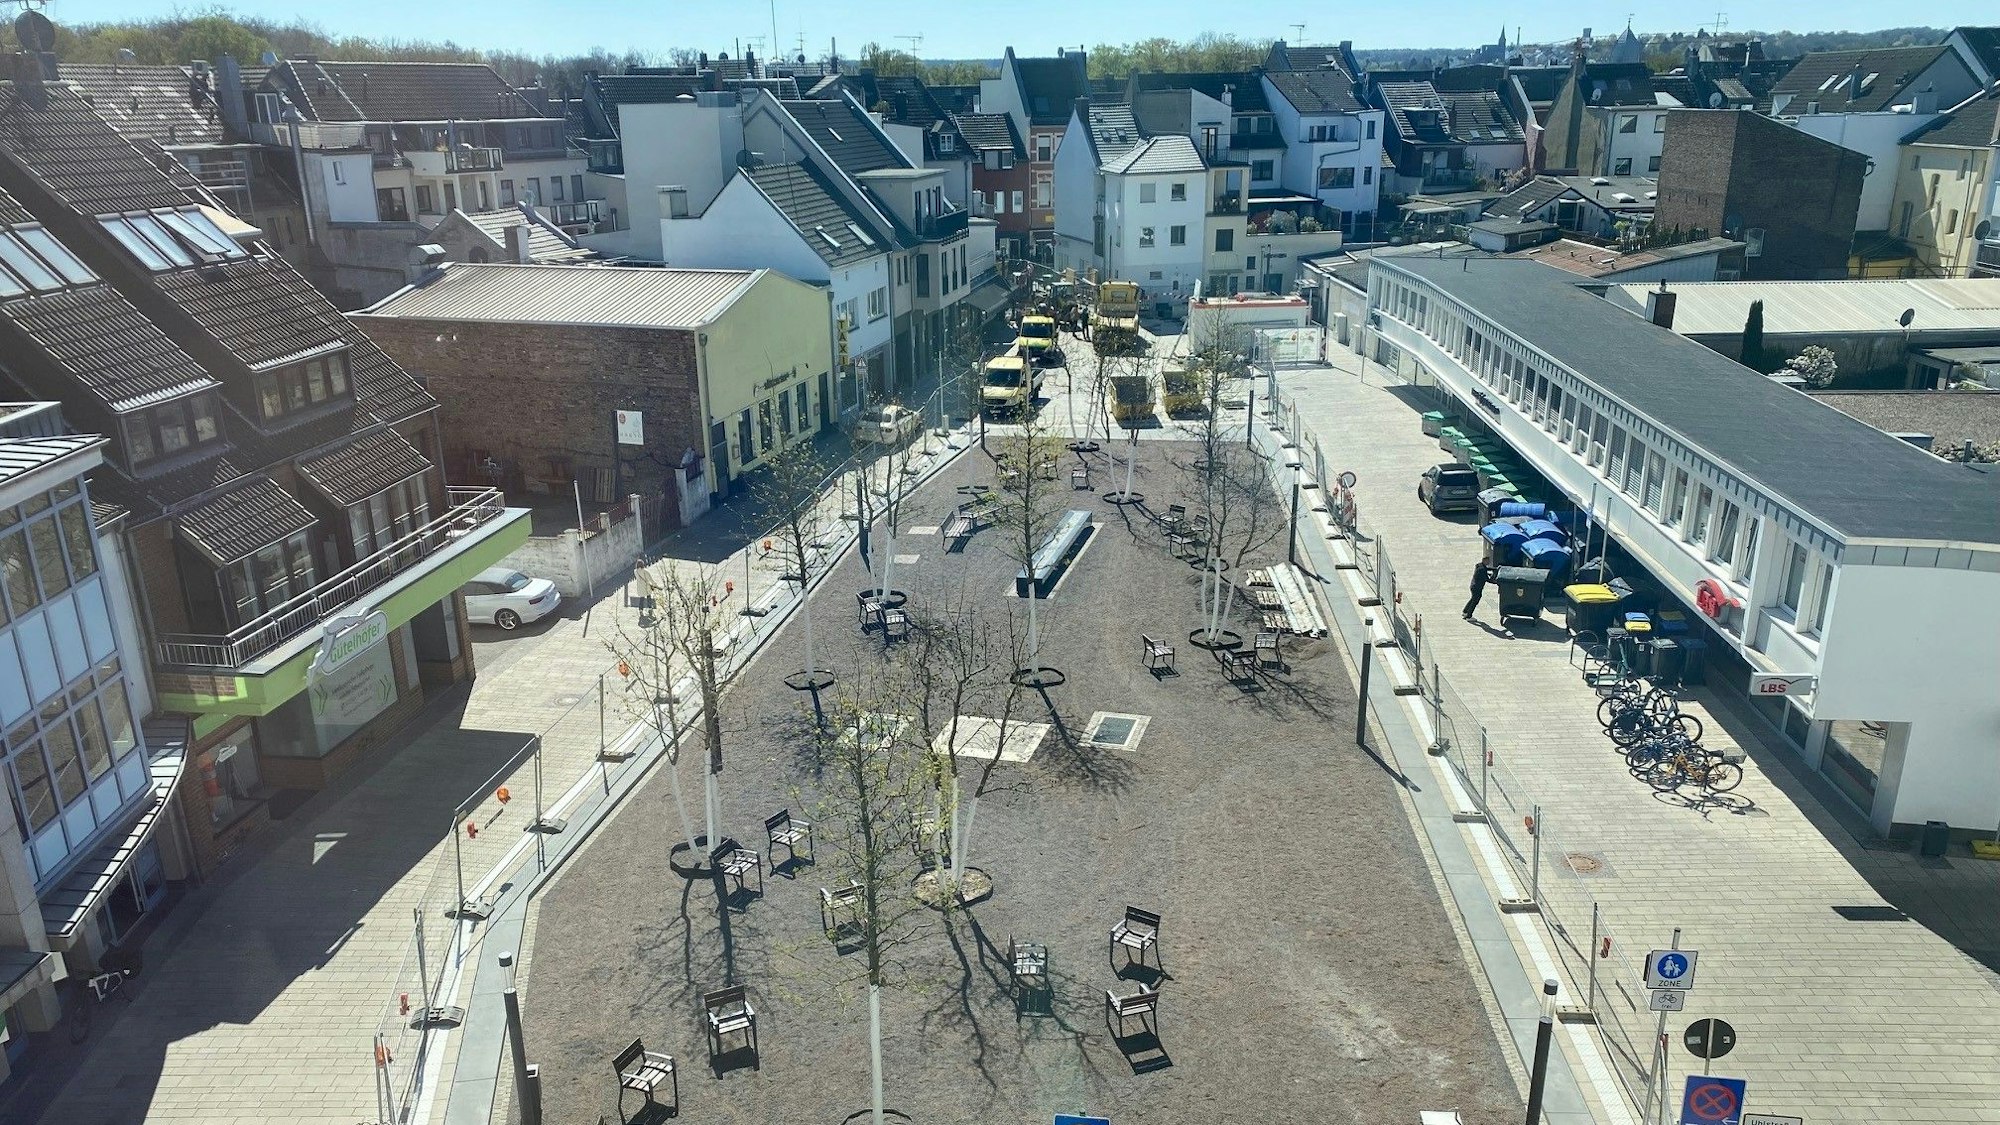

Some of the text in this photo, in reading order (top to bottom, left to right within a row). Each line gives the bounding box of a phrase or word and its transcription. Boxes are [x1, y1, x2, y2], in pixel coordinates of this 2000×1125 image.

[838, 320, 848, 365] TAXI
[329, 622, 381, 663] Gütelhöfer
[1760, 683, 1787, 693] LBS
